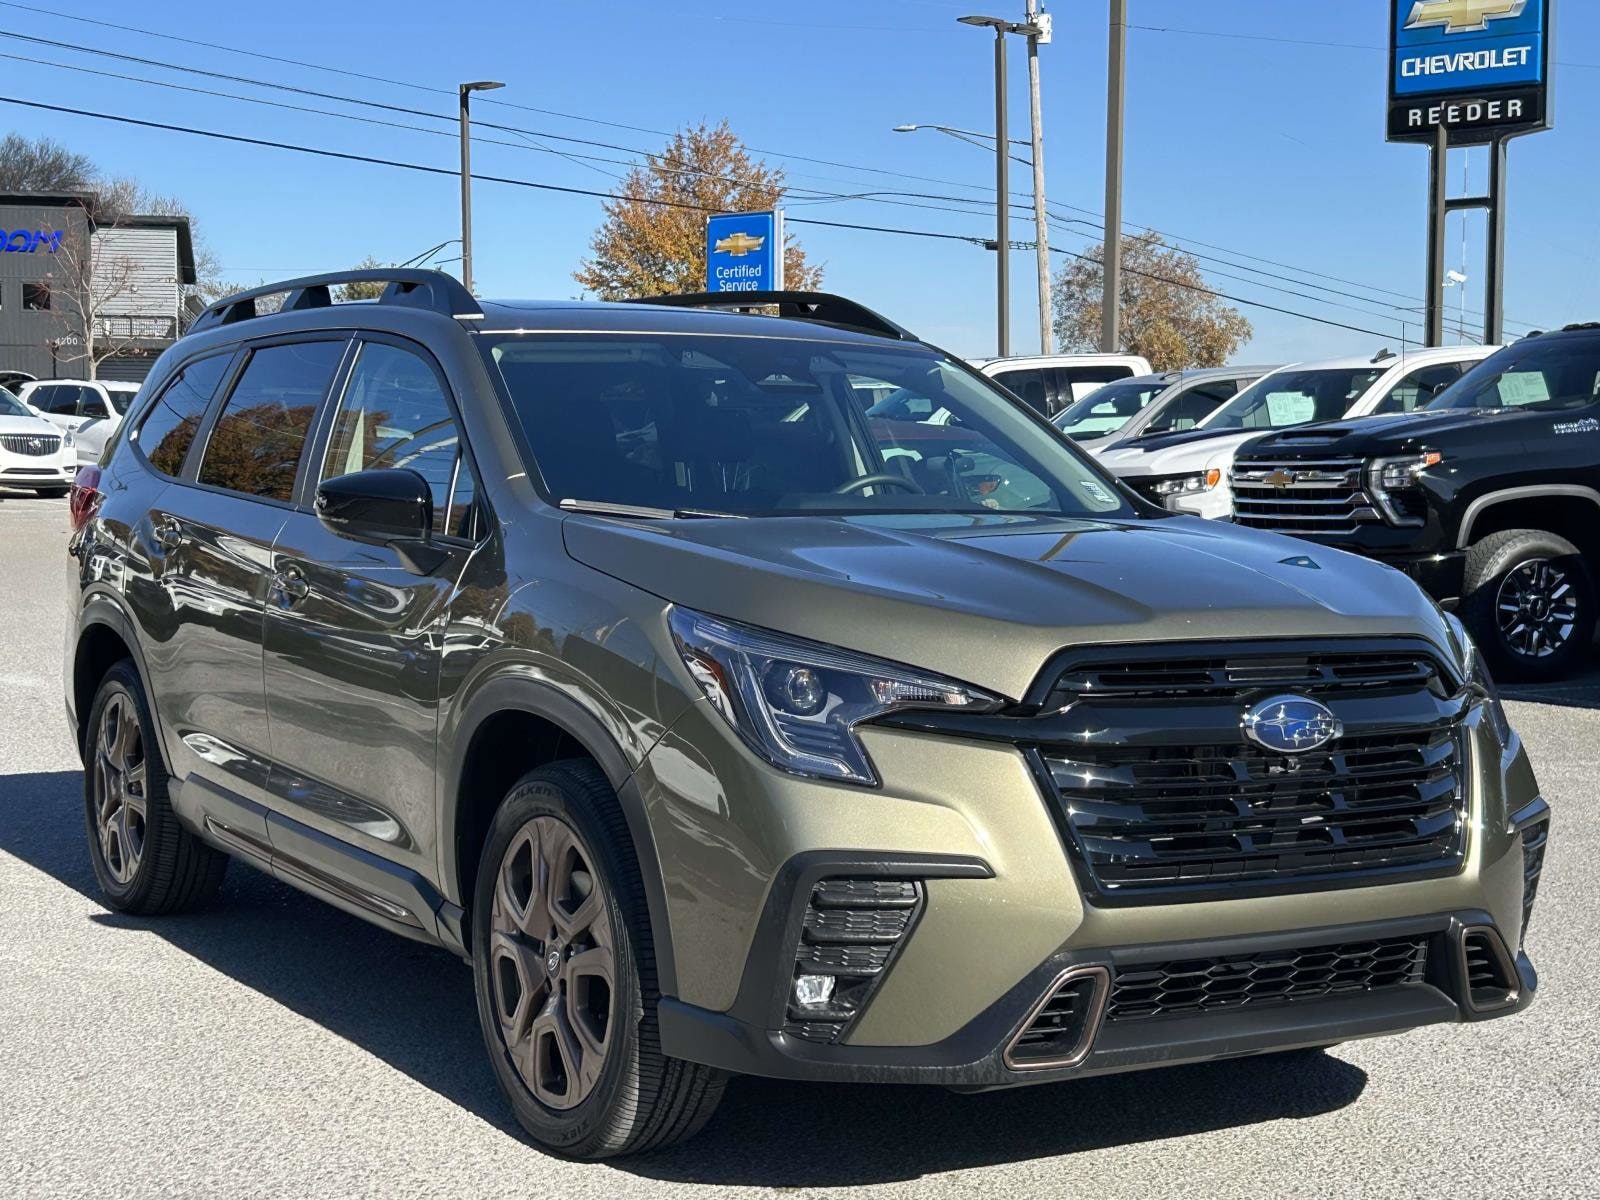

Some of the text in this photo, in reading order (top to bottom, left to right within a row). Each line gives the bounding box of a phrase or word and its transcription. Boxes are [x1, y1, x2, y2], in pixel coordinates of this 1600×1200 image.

[1401, 46, 1531, 77] CHEVROLET
[1408, 99, 1523, 127] REEDER
[716, 264, 762, 279] Certified
[719, 278, 759, 292] Service
